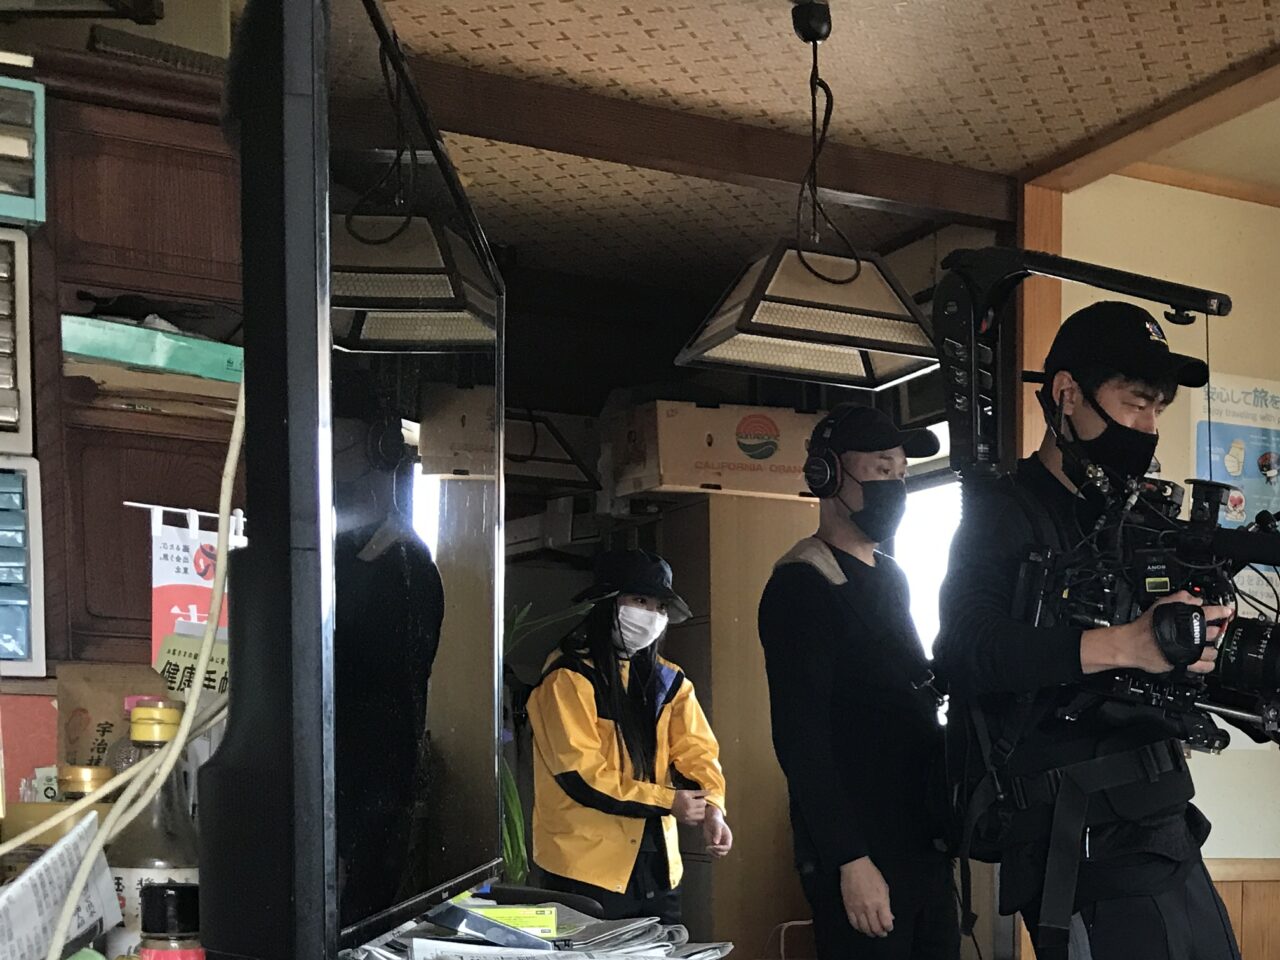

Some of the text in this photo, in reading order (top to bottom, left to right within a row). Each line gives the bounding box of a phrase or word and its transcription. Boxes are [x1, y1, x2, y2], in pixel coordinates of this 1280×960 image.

[694, 460, 803, 475] CALIFORNIA ORAN
[1192, 612, 1201, 645] Canon
